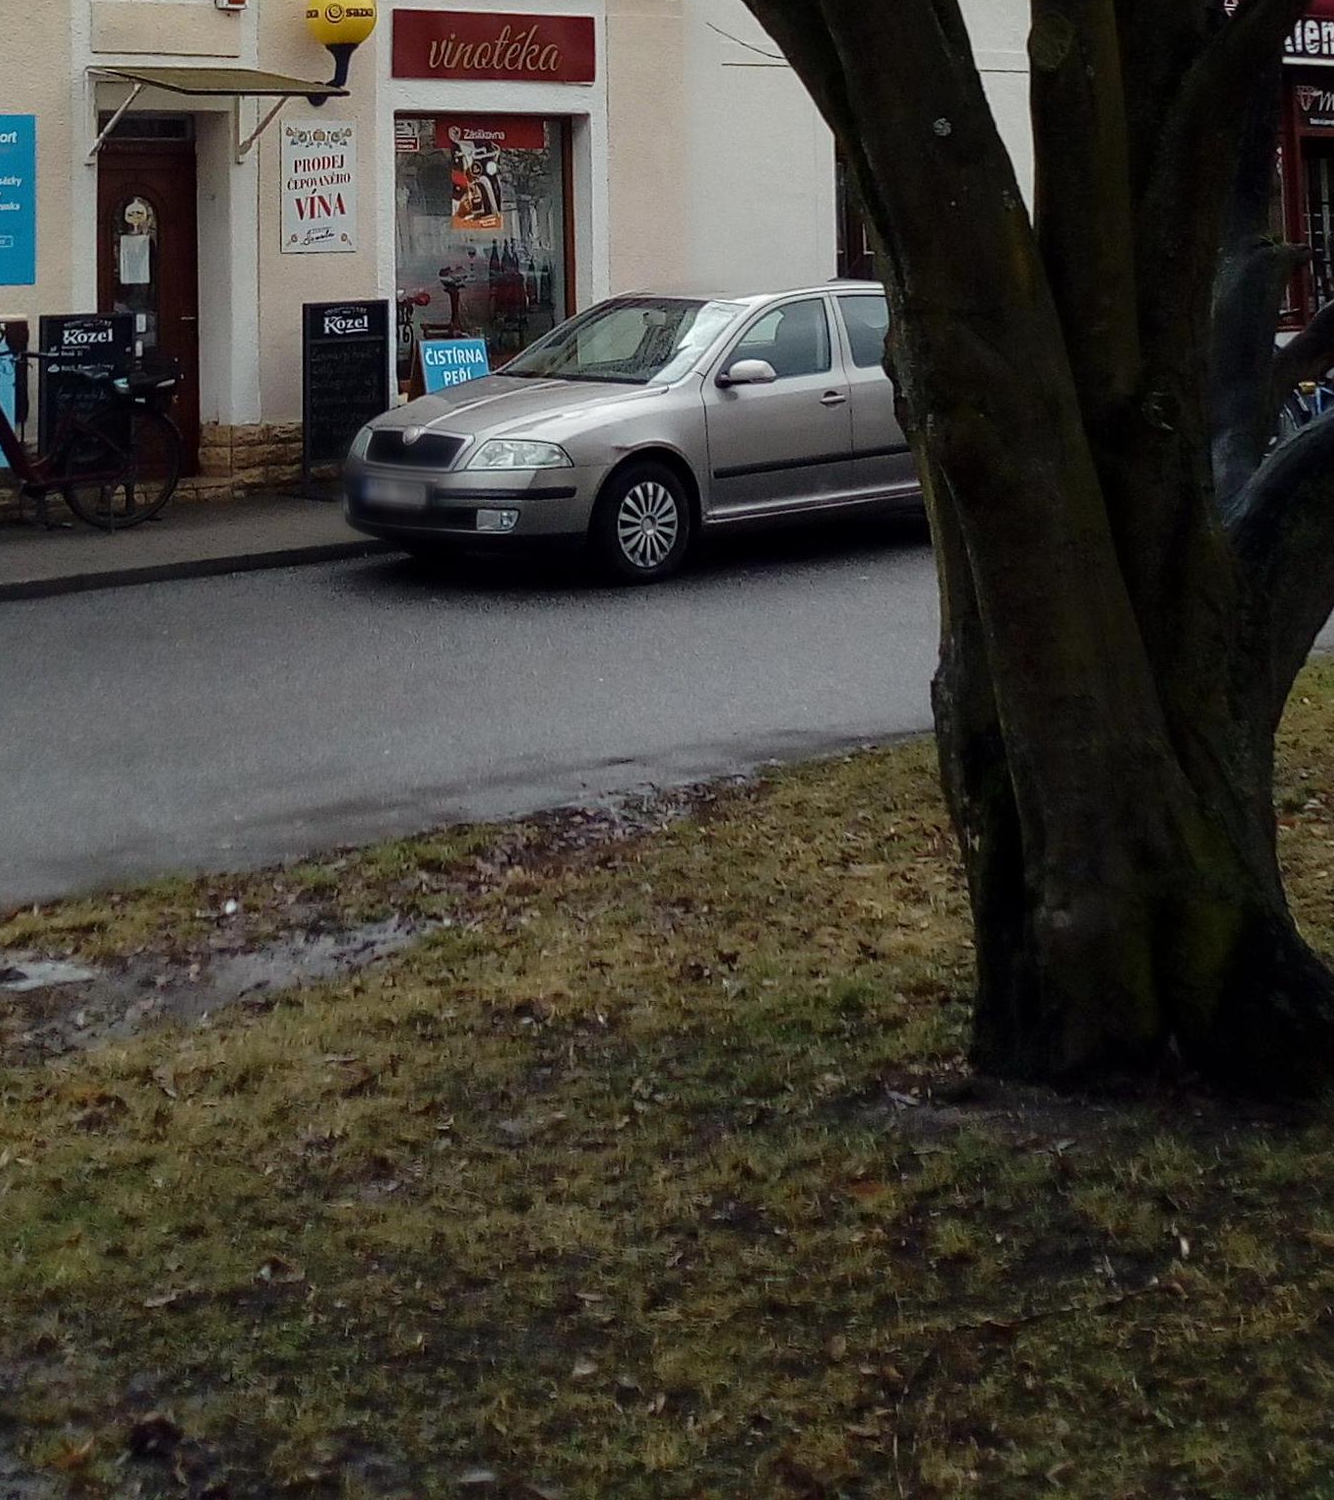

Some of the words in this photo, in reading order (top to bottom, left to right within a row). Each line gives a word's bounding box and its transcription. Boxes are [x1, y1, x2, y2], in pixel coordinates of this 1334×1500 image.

[428, 24, 561, 72] vinotéka
[294, 154, 344, 174] PRODEJ
[287, 172, 351, 191] ČEPOVANÉHO
[295, 188, 346, 221] VÍNA
[324, 315, 368, 334] Kozel
[63, 328, 113, 345] Kozel
[425, 346, 485, 366] ČISTÍRNA
